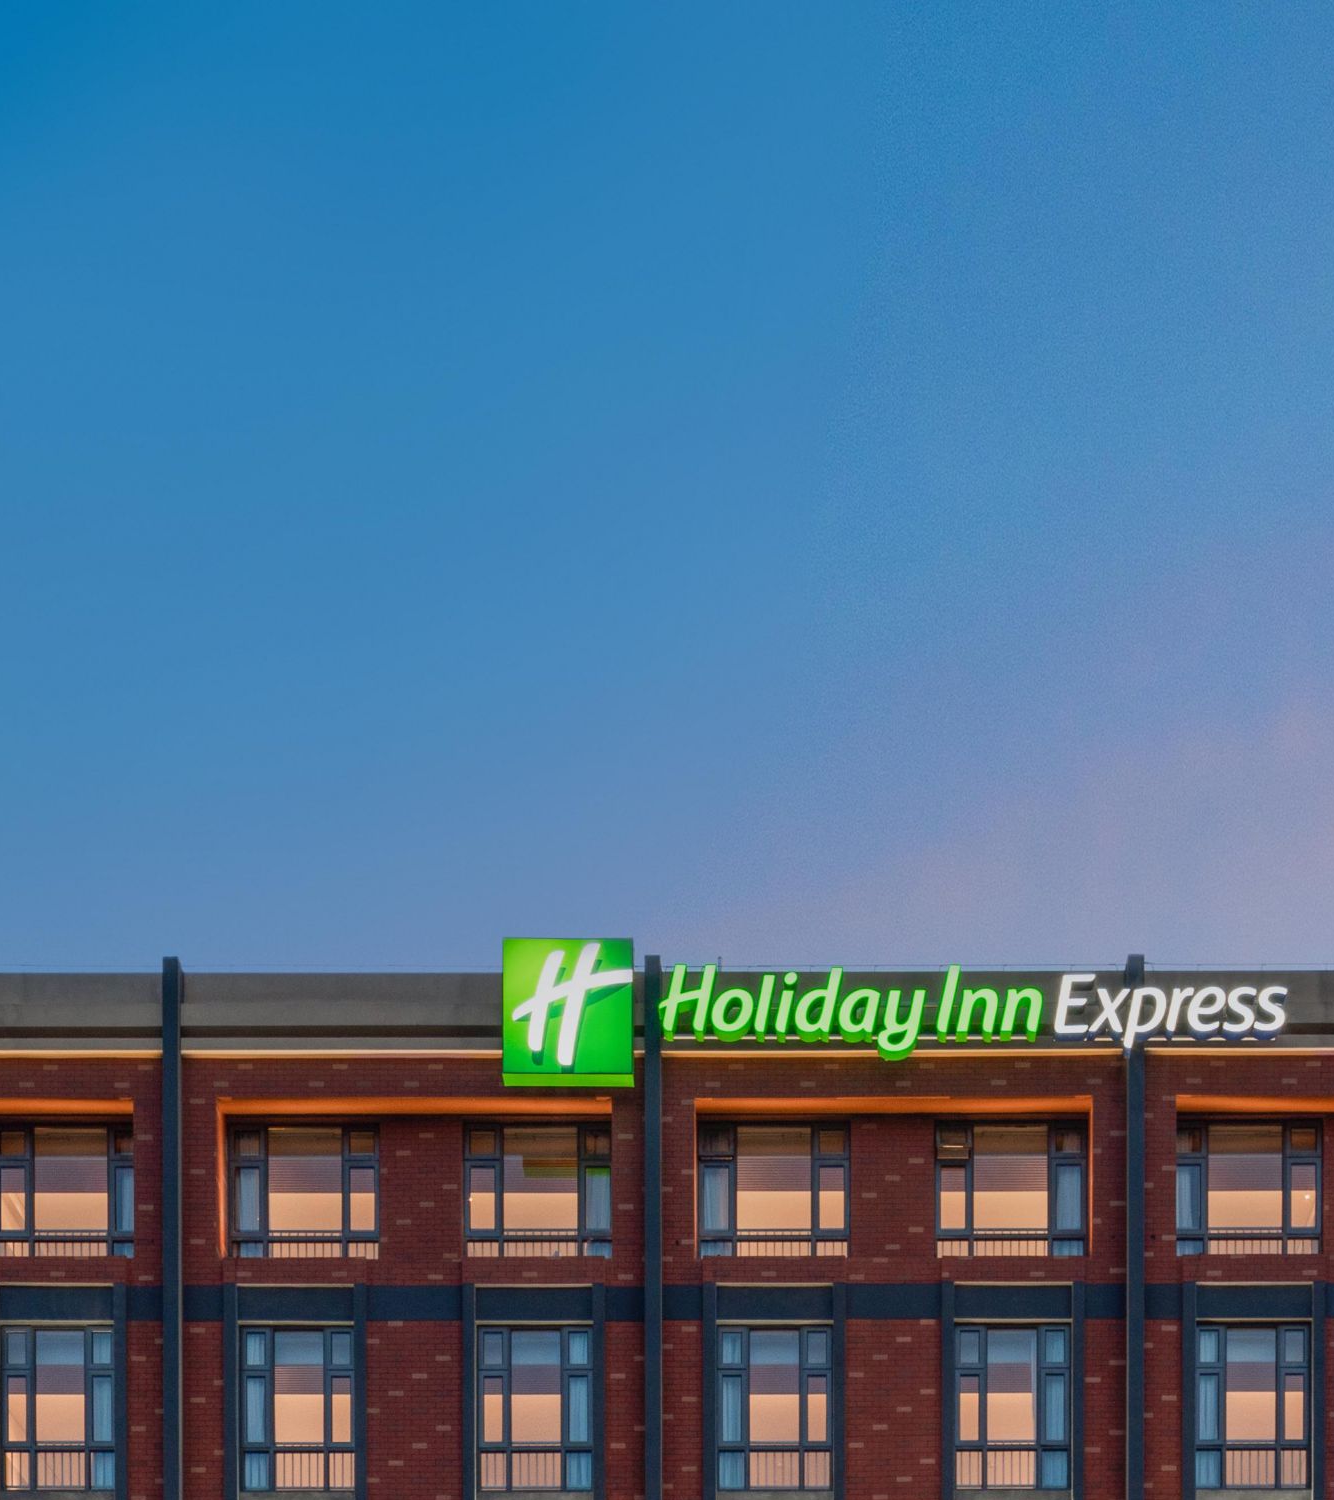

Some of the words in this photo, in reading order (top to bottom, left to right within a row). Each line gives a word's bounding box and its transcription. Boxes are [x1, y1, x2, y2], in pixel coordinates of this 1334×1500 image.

[658, 963, 926, 1056] Holiday
[937, 963, 1043, 1039] Inn
[1053, 973, 1288, 1050] Express
